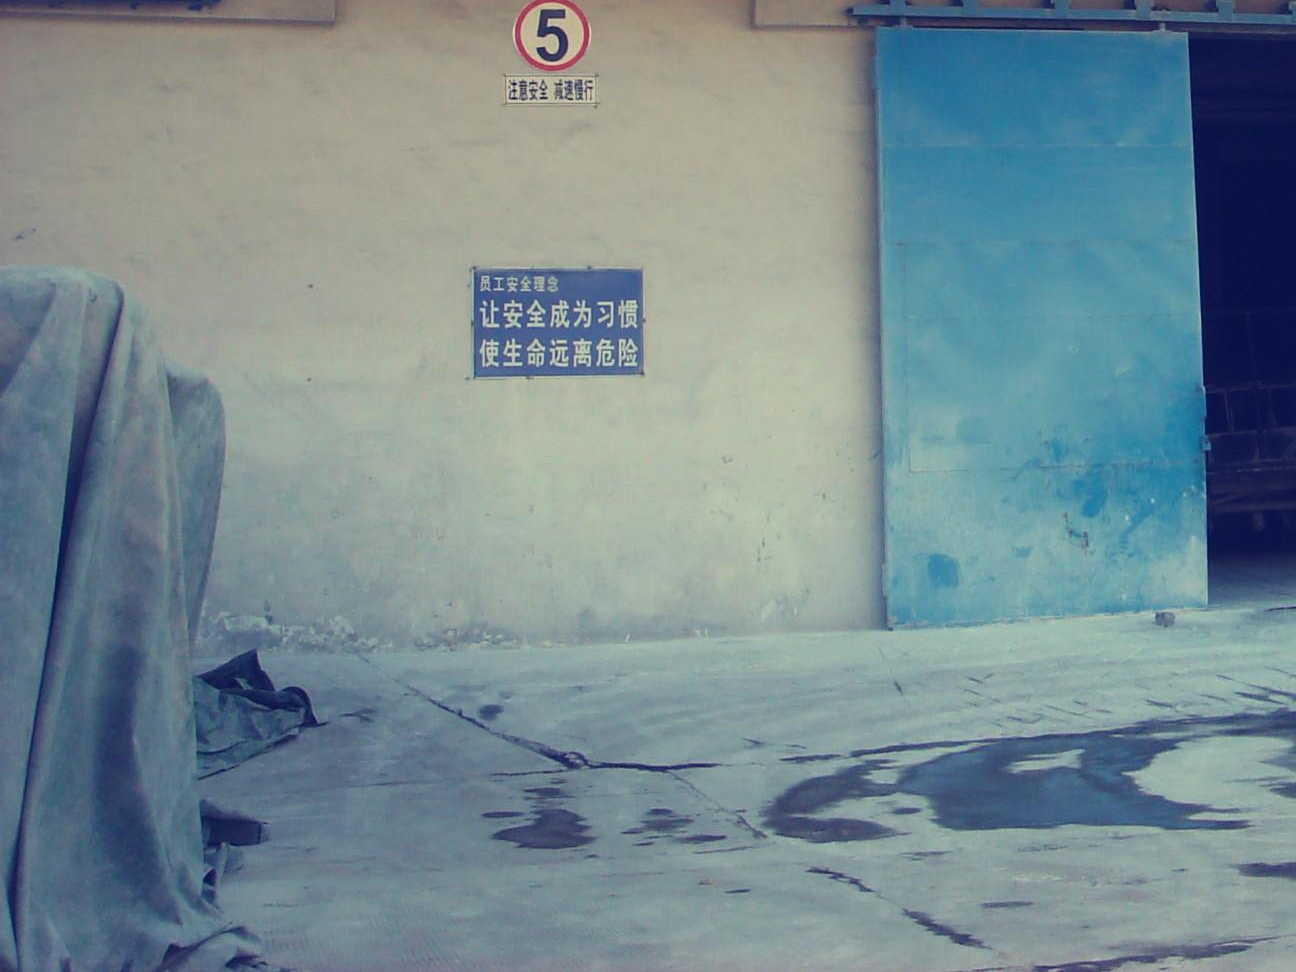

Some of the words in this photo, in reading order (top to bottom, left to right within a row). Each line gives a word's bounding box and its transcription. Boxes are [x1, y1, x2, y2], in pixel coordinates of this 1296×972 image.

[535, 8, 569, 63] 5
[507, 78, 548, 101] 注意安全
[553, 78, 594, 101] 减速慢行
[479, 275, 560, 293] 员工安全理念
[479, 299, 639, 329] 让安全成为习惯
[479, 338, 639, 368] 使生命远离危险
